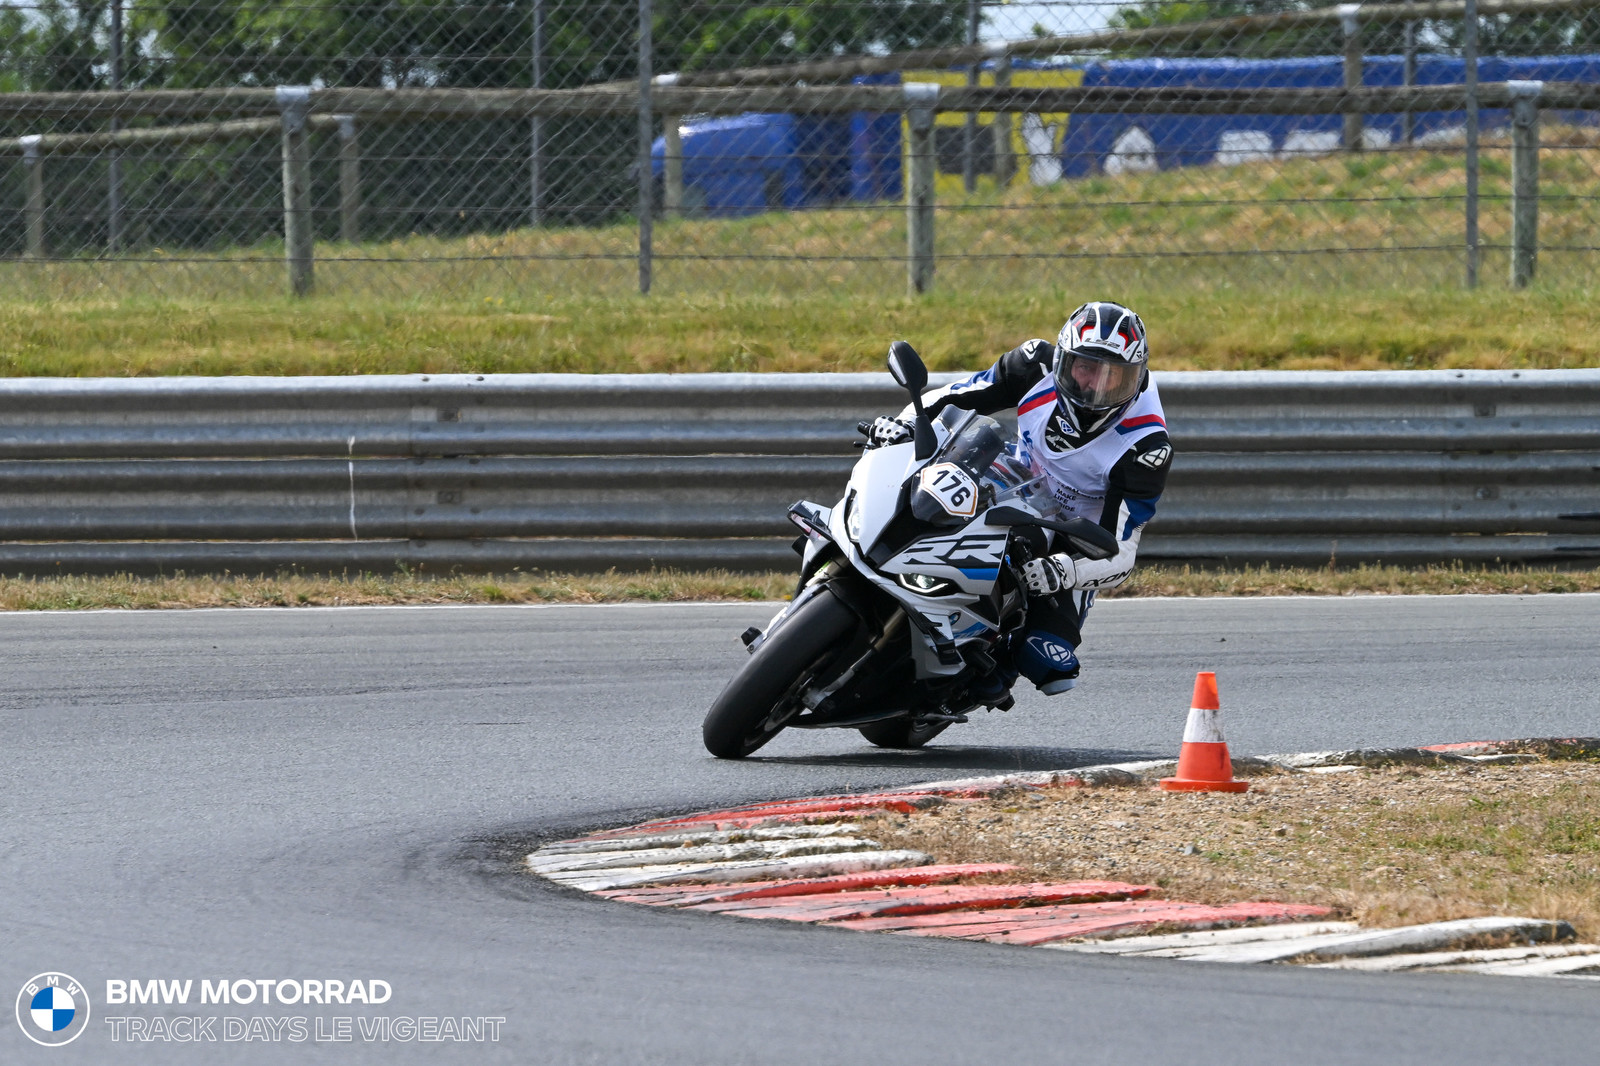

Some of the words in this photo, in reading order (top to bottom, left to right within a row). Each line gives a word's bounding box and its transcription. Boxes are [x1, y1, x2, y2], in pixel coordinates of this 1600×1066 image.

[932, 469, 971, 507] 176
[1056, 488, 1077, 501] MAKE
[1053, 494, 1069, 505] LIFE
